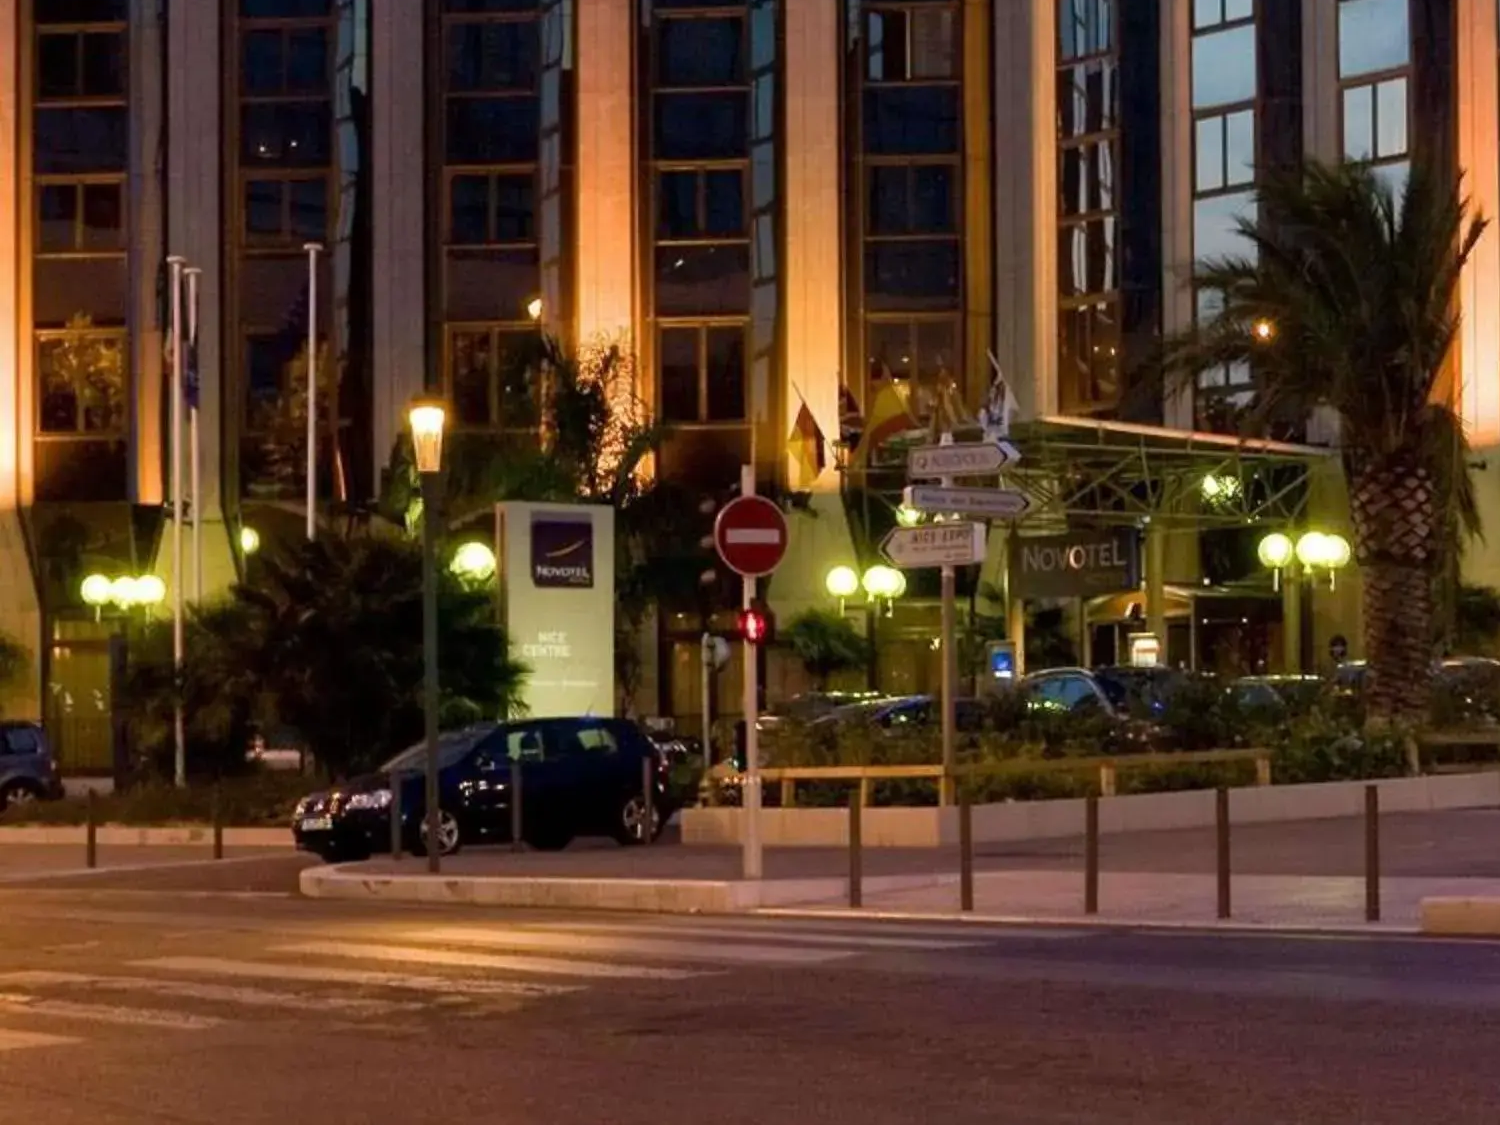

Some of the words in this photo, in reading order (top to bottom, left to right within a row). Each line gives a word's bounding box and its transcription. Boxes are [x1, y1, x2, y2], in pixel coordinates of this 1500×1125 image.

[1022, 537, 1127, 574] NOVOTEL
[536, 565, 590, 578] NOVOTEL
[522, 644, 572, 659] CENTRE
